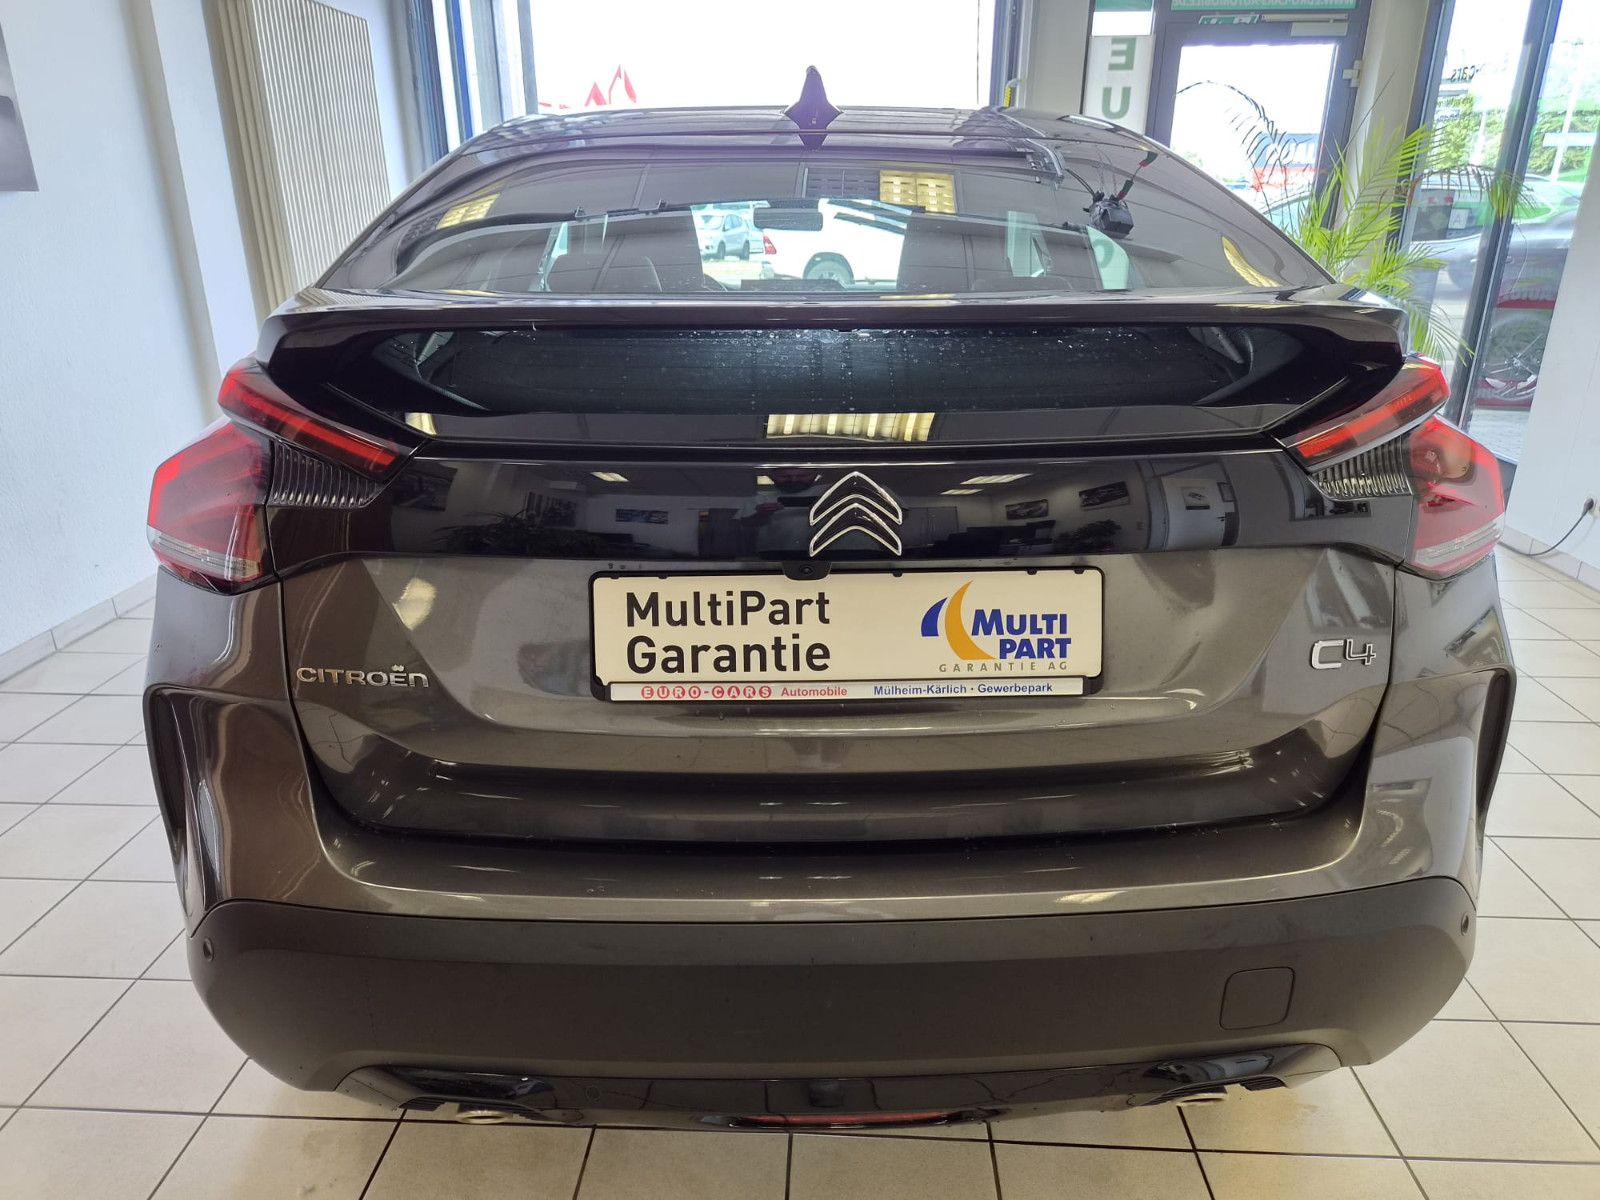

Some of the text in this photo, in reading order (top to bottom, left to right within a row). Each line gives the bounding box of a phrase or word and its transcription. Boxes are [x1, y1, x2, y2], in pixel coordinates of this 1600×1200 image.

[626, 590, 830, 627] MultiPart
[971, 609, 1068, 636] MULTI
[627, 633, 831, 674] Garantie
[999, 638, 1072, 659] PART
[1311, 638, 1377, 669] C4
[938, 661, 1068, 673] GARANTIE AG
[641, 683, 1053, 700] EURO-CARS Automobile Mülheim-Kärlich Gewerbepark
